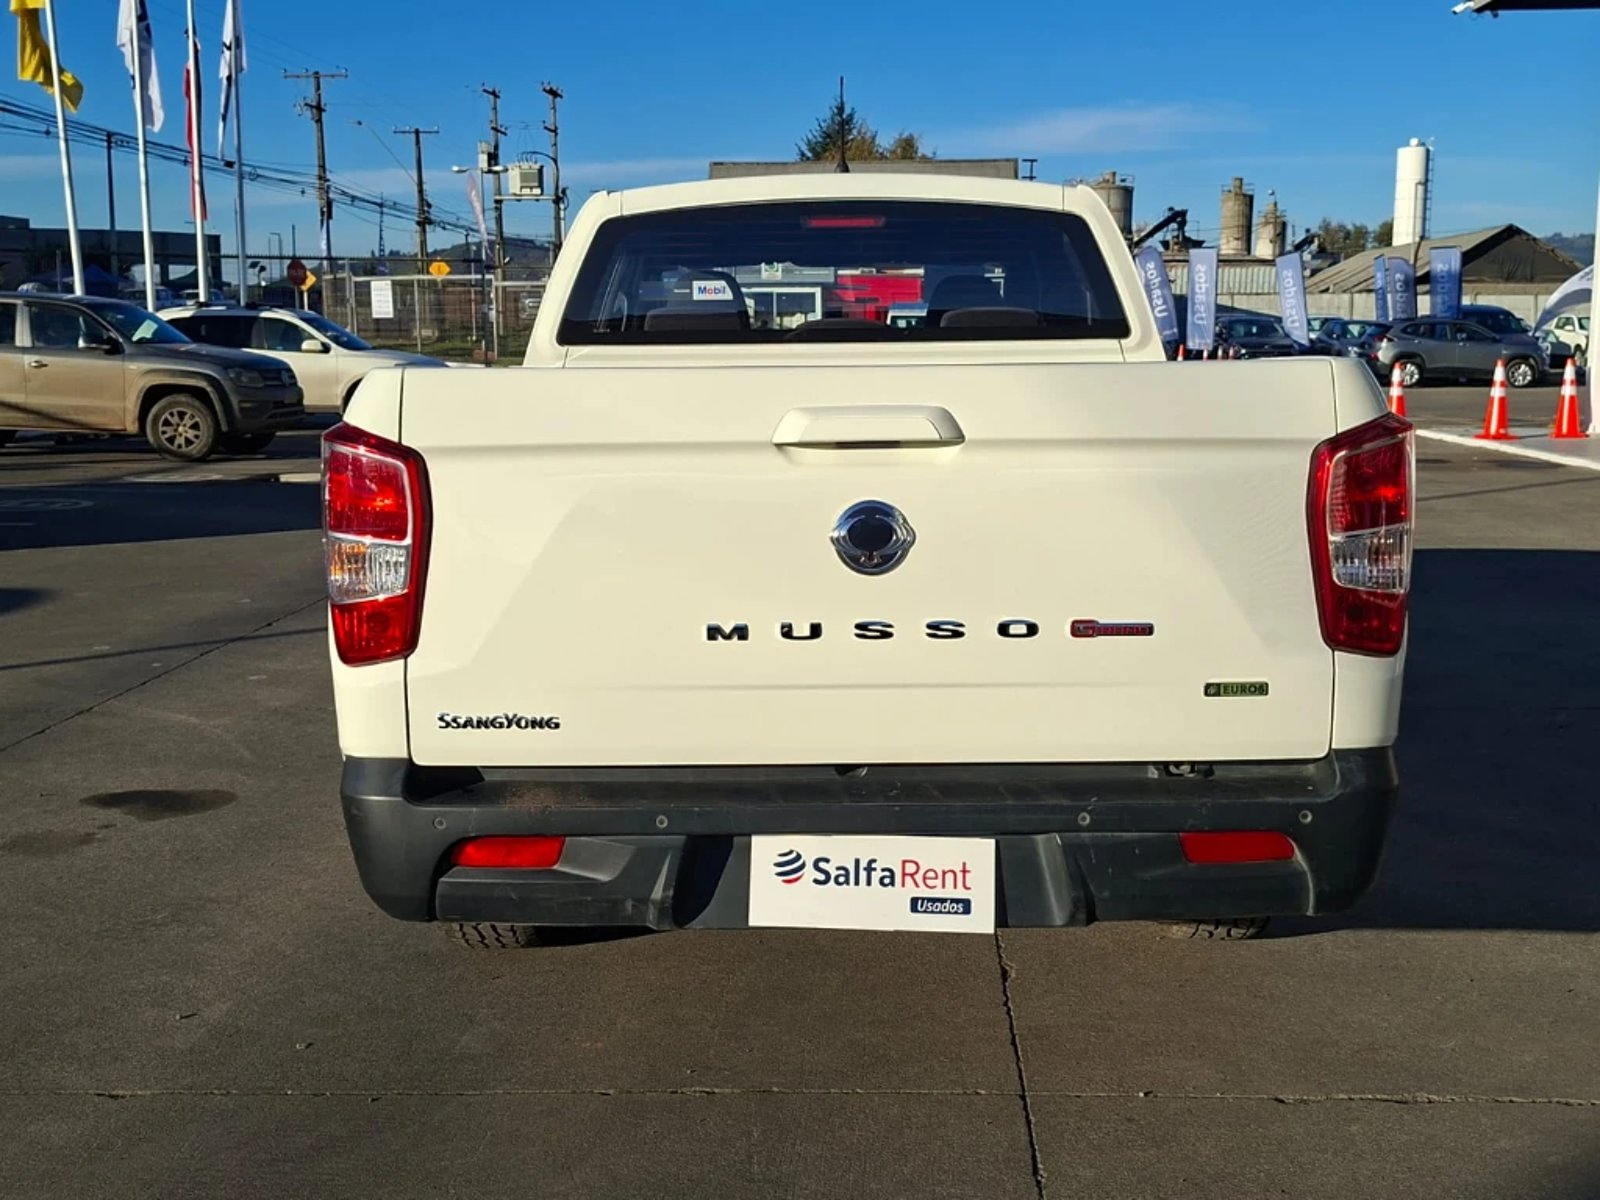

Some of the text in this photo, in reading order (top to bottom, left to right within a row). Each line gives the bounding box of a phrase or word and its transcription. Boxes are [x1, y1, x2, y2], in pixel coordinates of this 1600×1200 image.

[697, 285, 726, 295] Mobil
[706, 620, 1040, 641] MUSSO
[917, 898, 964, 914] Usados
